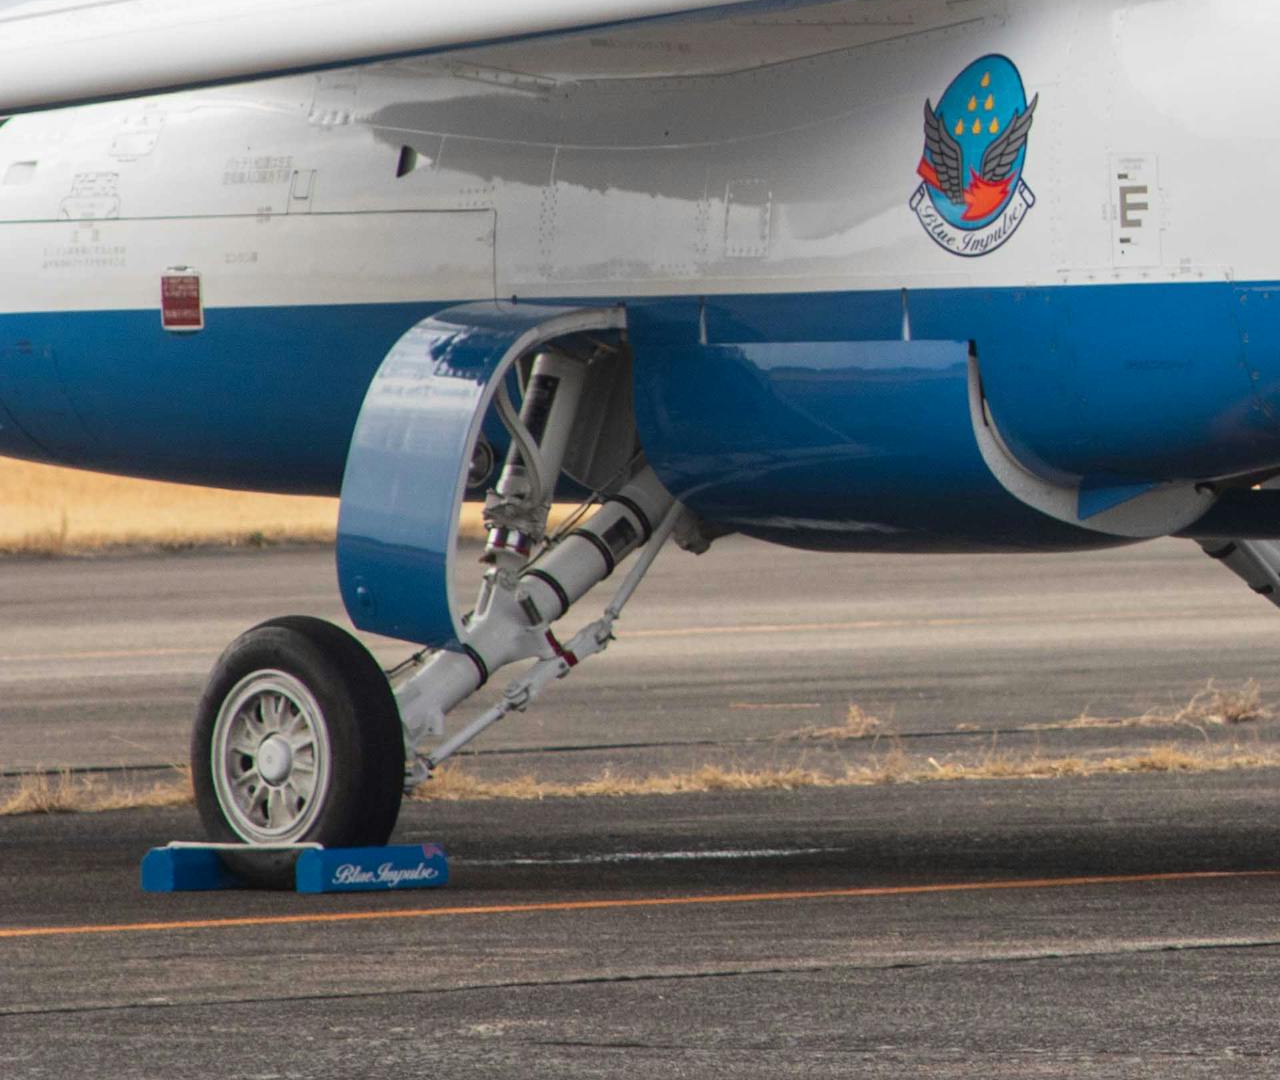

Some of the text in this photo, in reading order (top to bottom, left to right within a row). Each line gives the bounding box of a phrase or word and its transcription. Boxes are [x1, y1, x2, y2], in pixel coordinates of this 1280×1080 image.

[922, 204, 1023, 252] Blue Impulse
[1119, 184, 1149, 228] E
[332, 862, 440, 887] Blue Impulse
